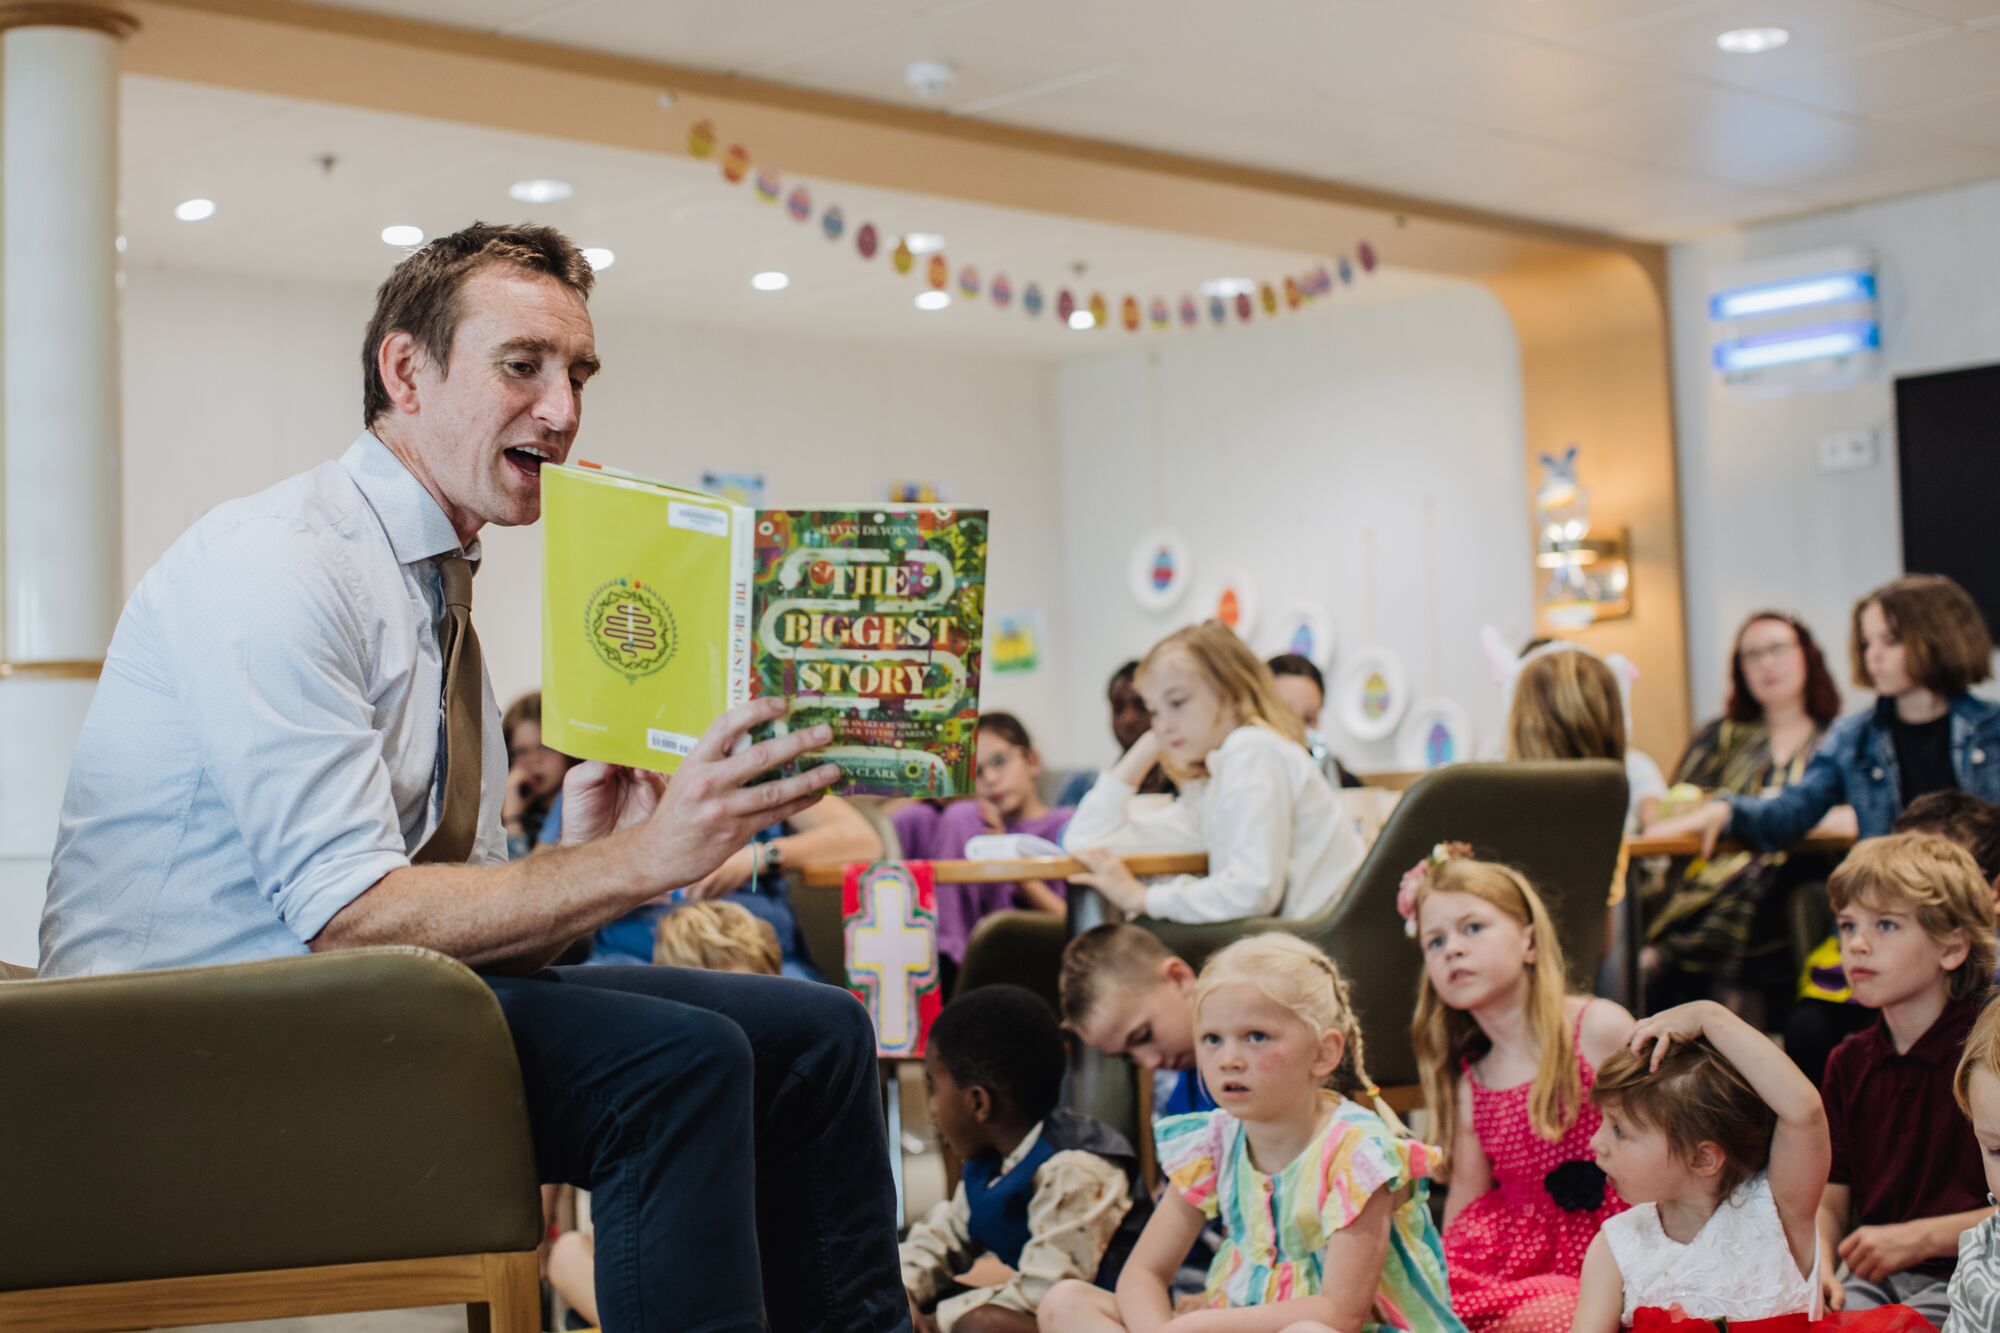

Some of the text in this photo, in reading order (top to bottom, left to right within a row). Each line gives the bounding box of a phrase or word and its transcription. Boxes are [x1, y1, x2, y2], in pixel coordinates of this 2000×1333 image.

[821, 525, 860, 536] KEVIN
[826, 565, 910, 596] THE
[783, 613, 958, 647] BIGGEST
[798, 662, 932, 695] STORY
[897, 729, 934, 737] GARDEN
[856, 767, 898, 779] CLARK
